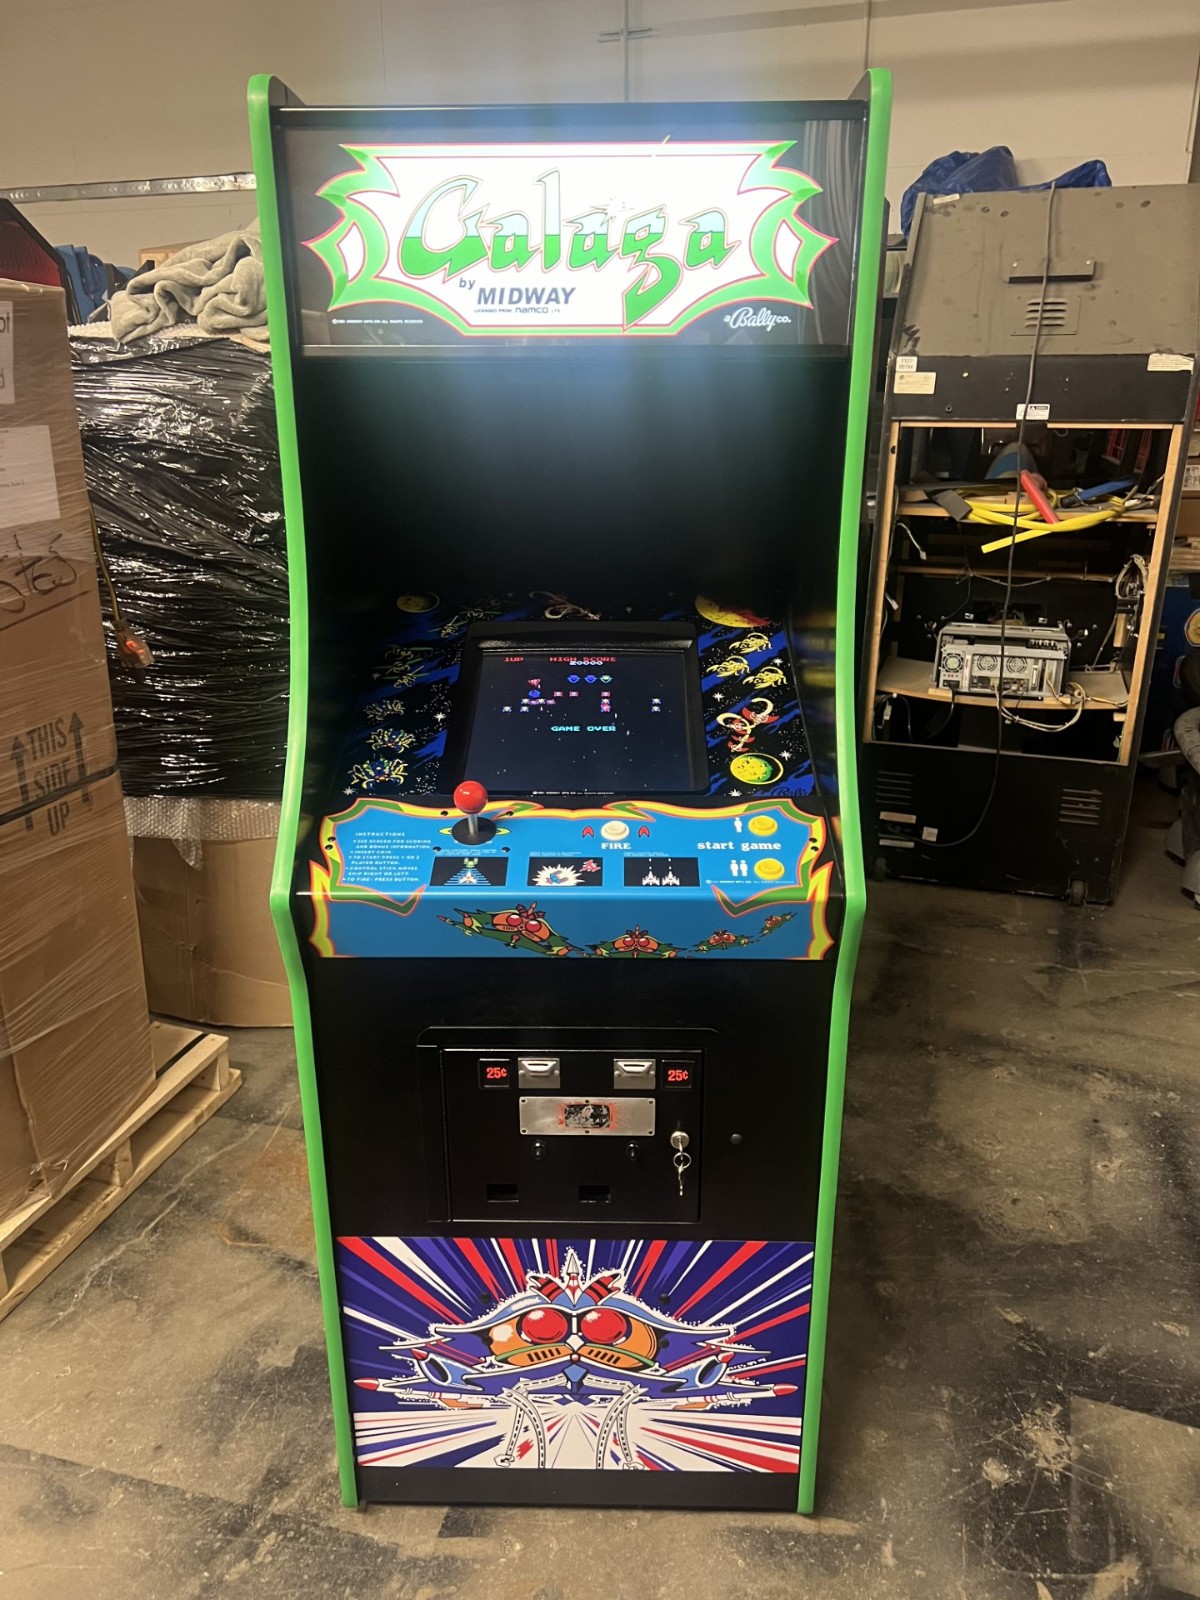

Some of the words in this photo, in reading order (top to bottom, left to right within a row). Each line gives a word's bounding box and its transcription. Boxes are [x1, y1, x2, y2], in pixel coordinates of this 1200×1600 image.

[398, 167, 741, 333] Galaga
[458, 277, 476, 290] by
[477, 287, 577, 305] MIDWAY
[515, 306, 549, 314] namco
[729, 306, 775, 332] Bally
[26, 717, 67, 761] THIS
[47, 801, 70, 836] UP
[601, 842, 632, 850] FIRE
[697, 841, 735, 850] start
[741, 842, 782, 852] game
[486, 1067, 508, 1079] 25¢
[667, 1069, 689, 1081] 25¢
